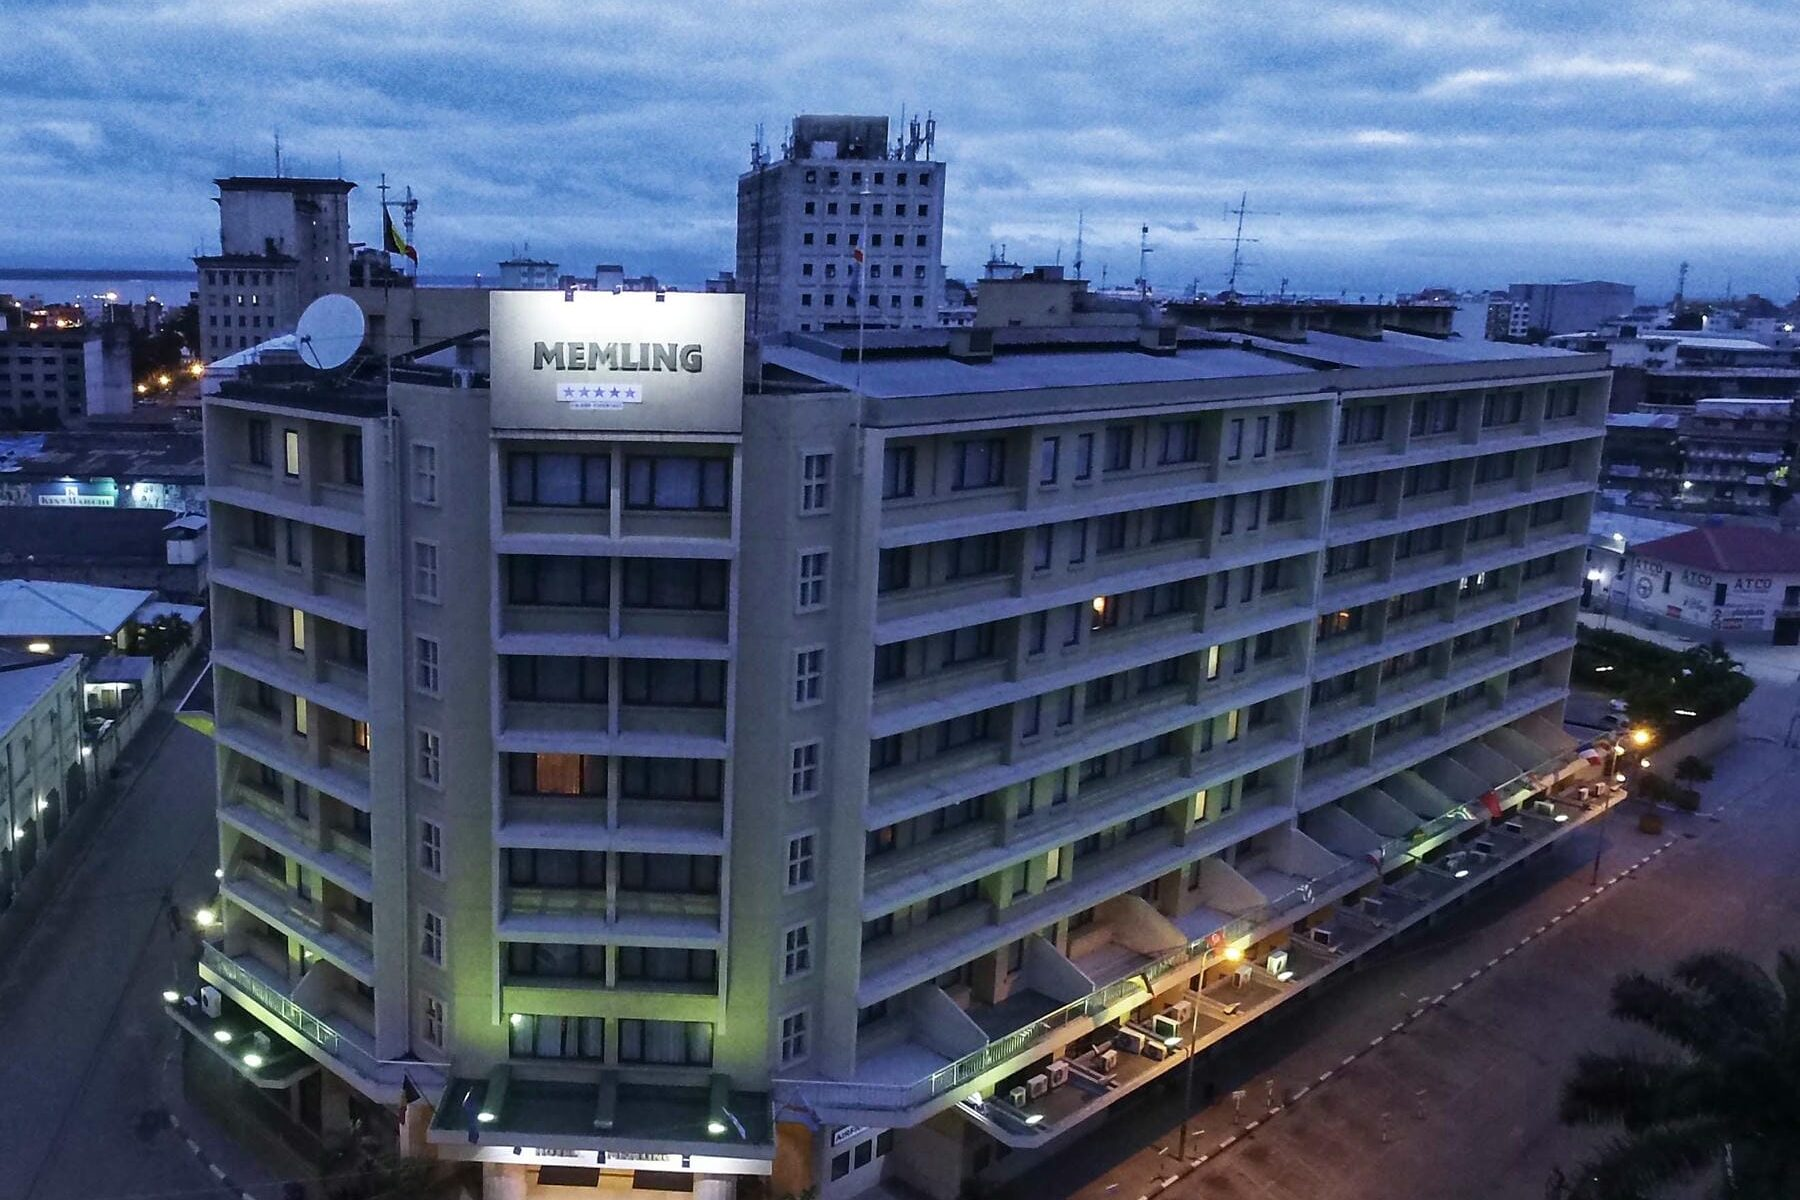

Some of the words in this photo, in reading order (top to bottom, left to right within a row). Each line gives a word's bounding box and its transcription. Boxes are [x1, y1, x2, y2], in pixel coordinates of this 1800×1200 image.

[533, 341, 703, 373] MEMLING
[1681, 569, 1712, 585] ATCO
[1734, 579, 1772, 589] ATCO
